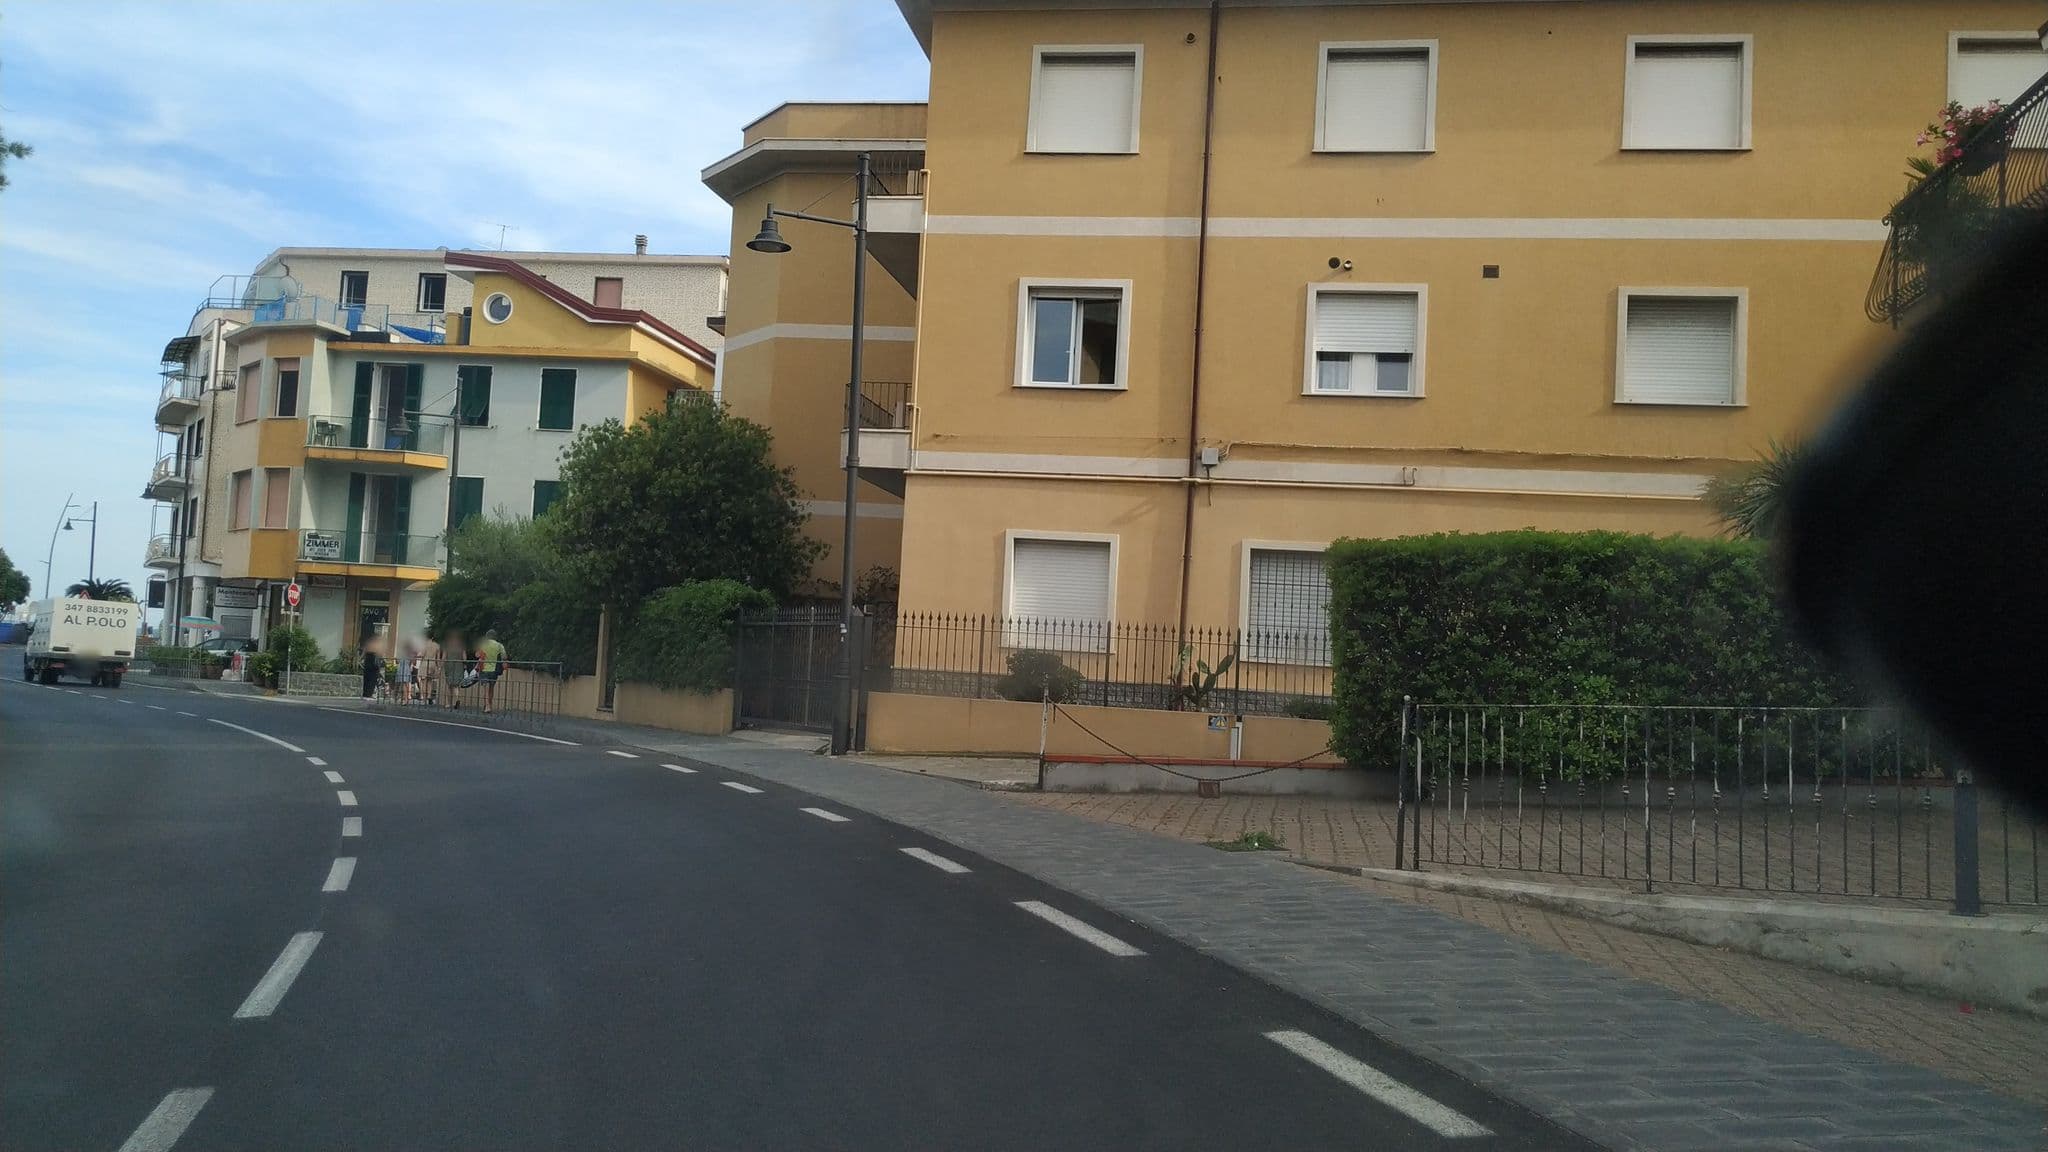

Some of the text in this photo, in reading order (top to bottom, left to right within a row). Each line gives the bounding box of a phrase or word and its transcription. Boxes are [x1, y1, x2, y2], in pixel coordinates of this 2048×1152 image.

[306, 540, 340, 548] ZIMMER
[289, 590, 299, 599] STOP
[65, 603, 129, 615] 347 8833199
[64, 615, 127, 628] AL P.OLO
